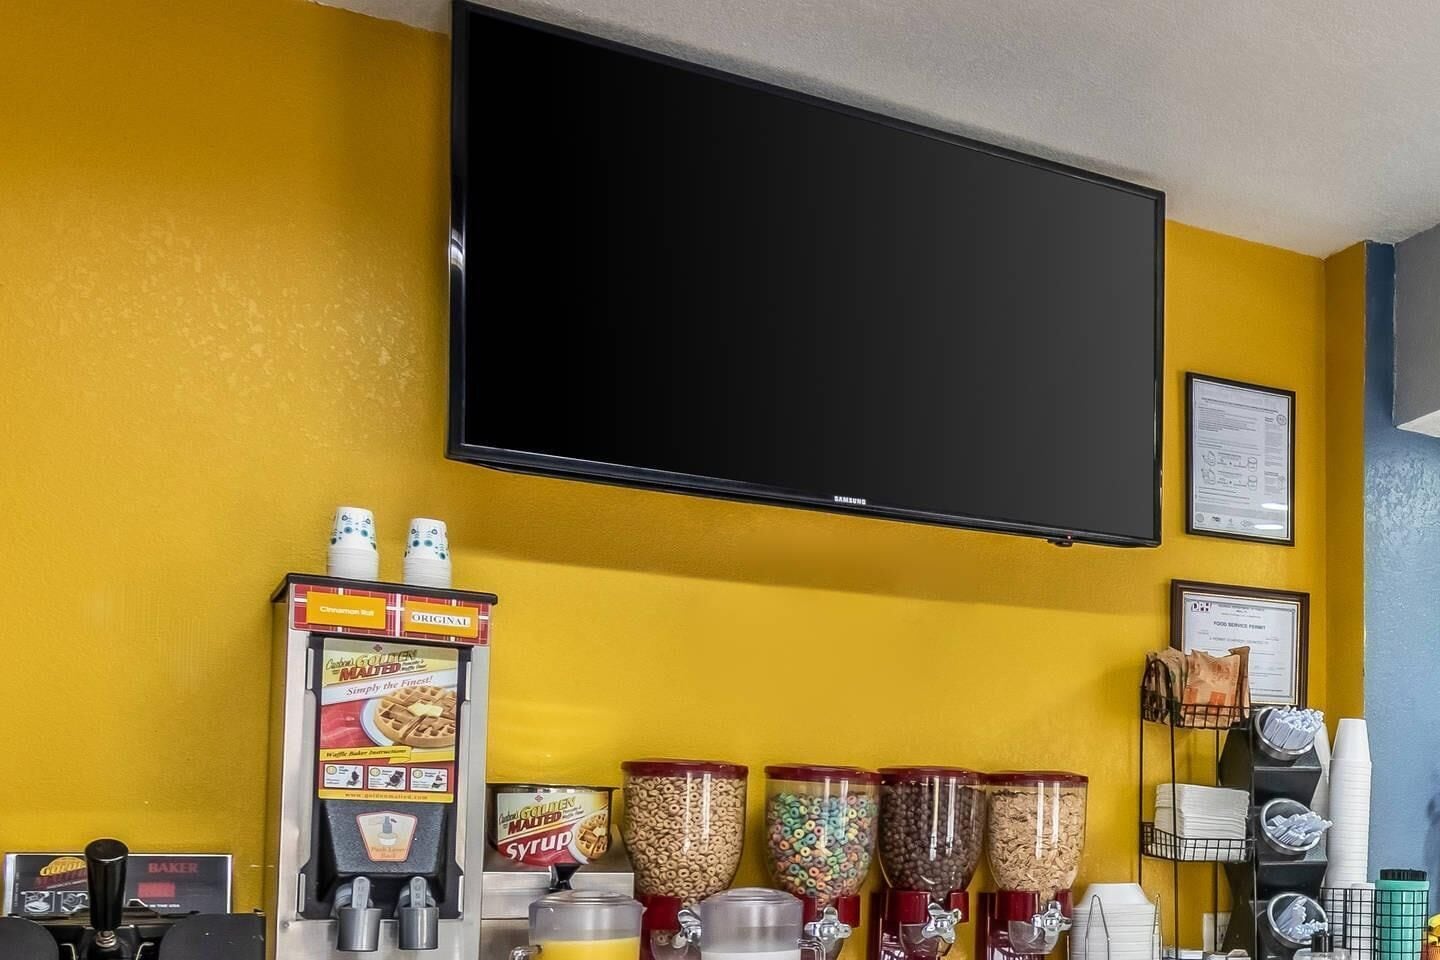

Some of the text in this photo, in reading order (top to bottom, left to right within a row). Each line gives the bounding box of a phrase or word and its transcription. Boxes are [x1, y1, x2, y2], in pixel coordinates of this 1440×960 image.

[834, 496, 866, 505] SAMSUNG
[412, 613, 468, 626] ORIGINAL
[355, 649, 417, 667] GOLDEN
[339, 663, 402, 681] MALTED
[346, 676, 433, 696] Simply the Finest!
[508, 811, 562, 835] MALTED
[506, 831, 572, 862] Syrup
[148, 863, 198, 873] BAKER
